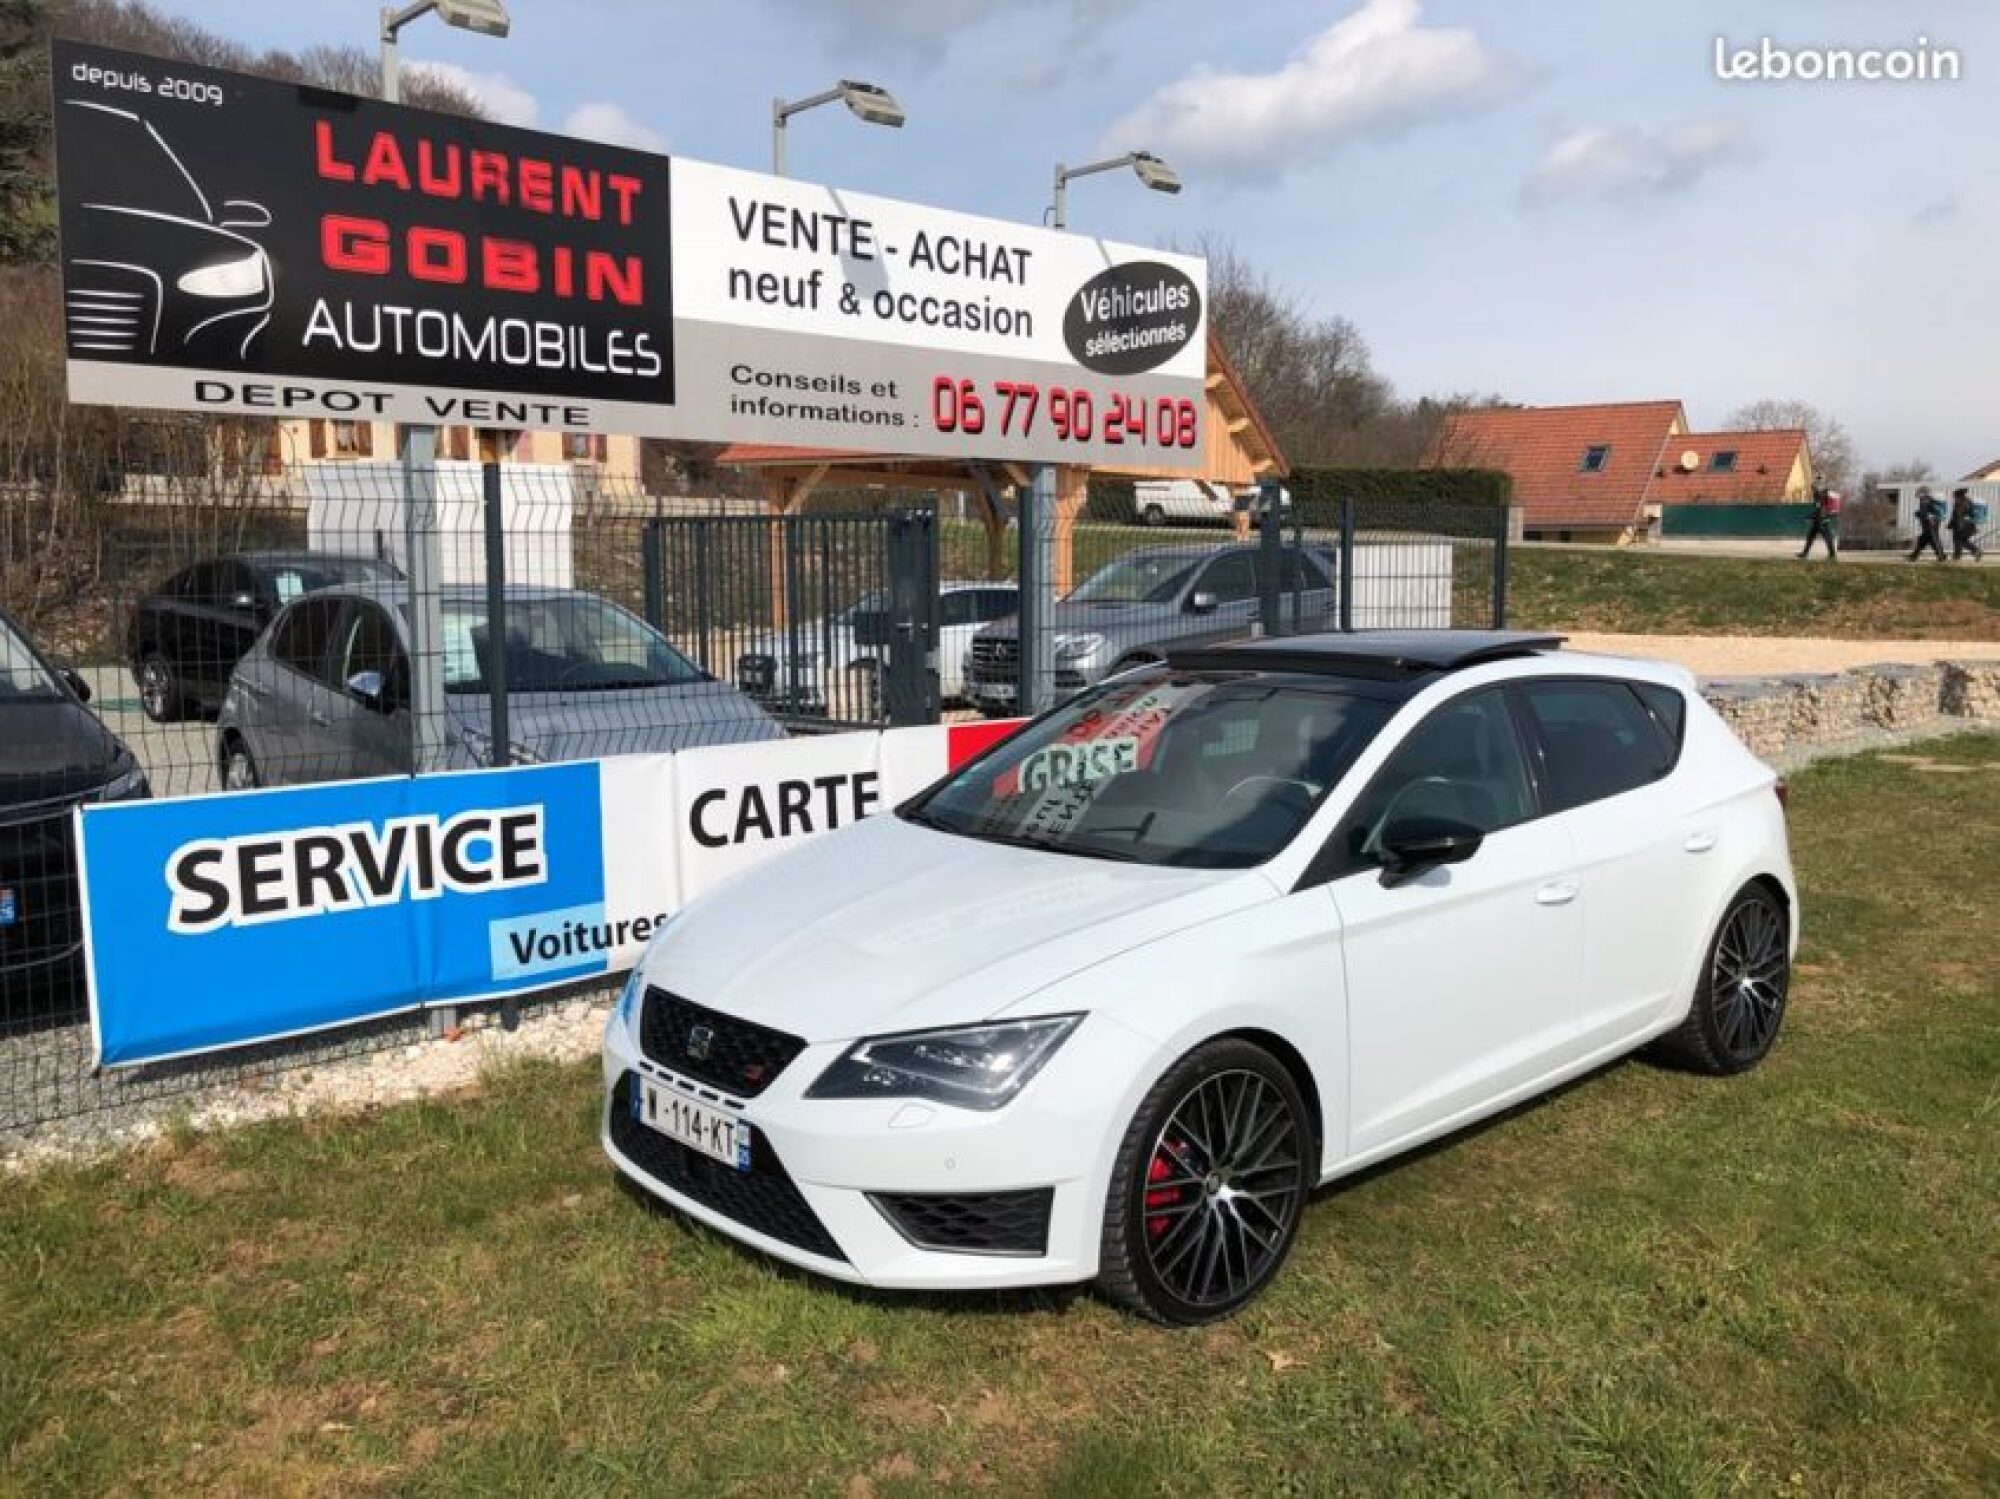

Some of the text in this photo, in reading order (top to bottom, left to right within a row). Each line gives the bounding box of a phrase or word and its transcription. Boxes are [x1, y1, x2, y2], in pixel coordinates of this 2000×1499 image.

[72, 63, 223, 106] depuis 2009
[315, 120, 642, 225] LAURENT
[321, 214, 642, 305] GOBIN
[728, 197, 874, 261] VENTE
[909, 231, 1033, 286] ACHAT
[728, 268, 1032, 338] neuf & occasion
[1081, 280, 1190, 322] Véhicules
[302, 298, 662, 377] AUTOMOBILES
[195, 381, 590, 426] DEPOT VENTE
[731, 365, 897, 398] Conseils et
[731, 396, 905, 427] informations
[932, 376, 1196, 448] 06 77 90 24 08
[176, 812, 540, 925] SERVICE
[690, 771, 878, 848] CARTE
